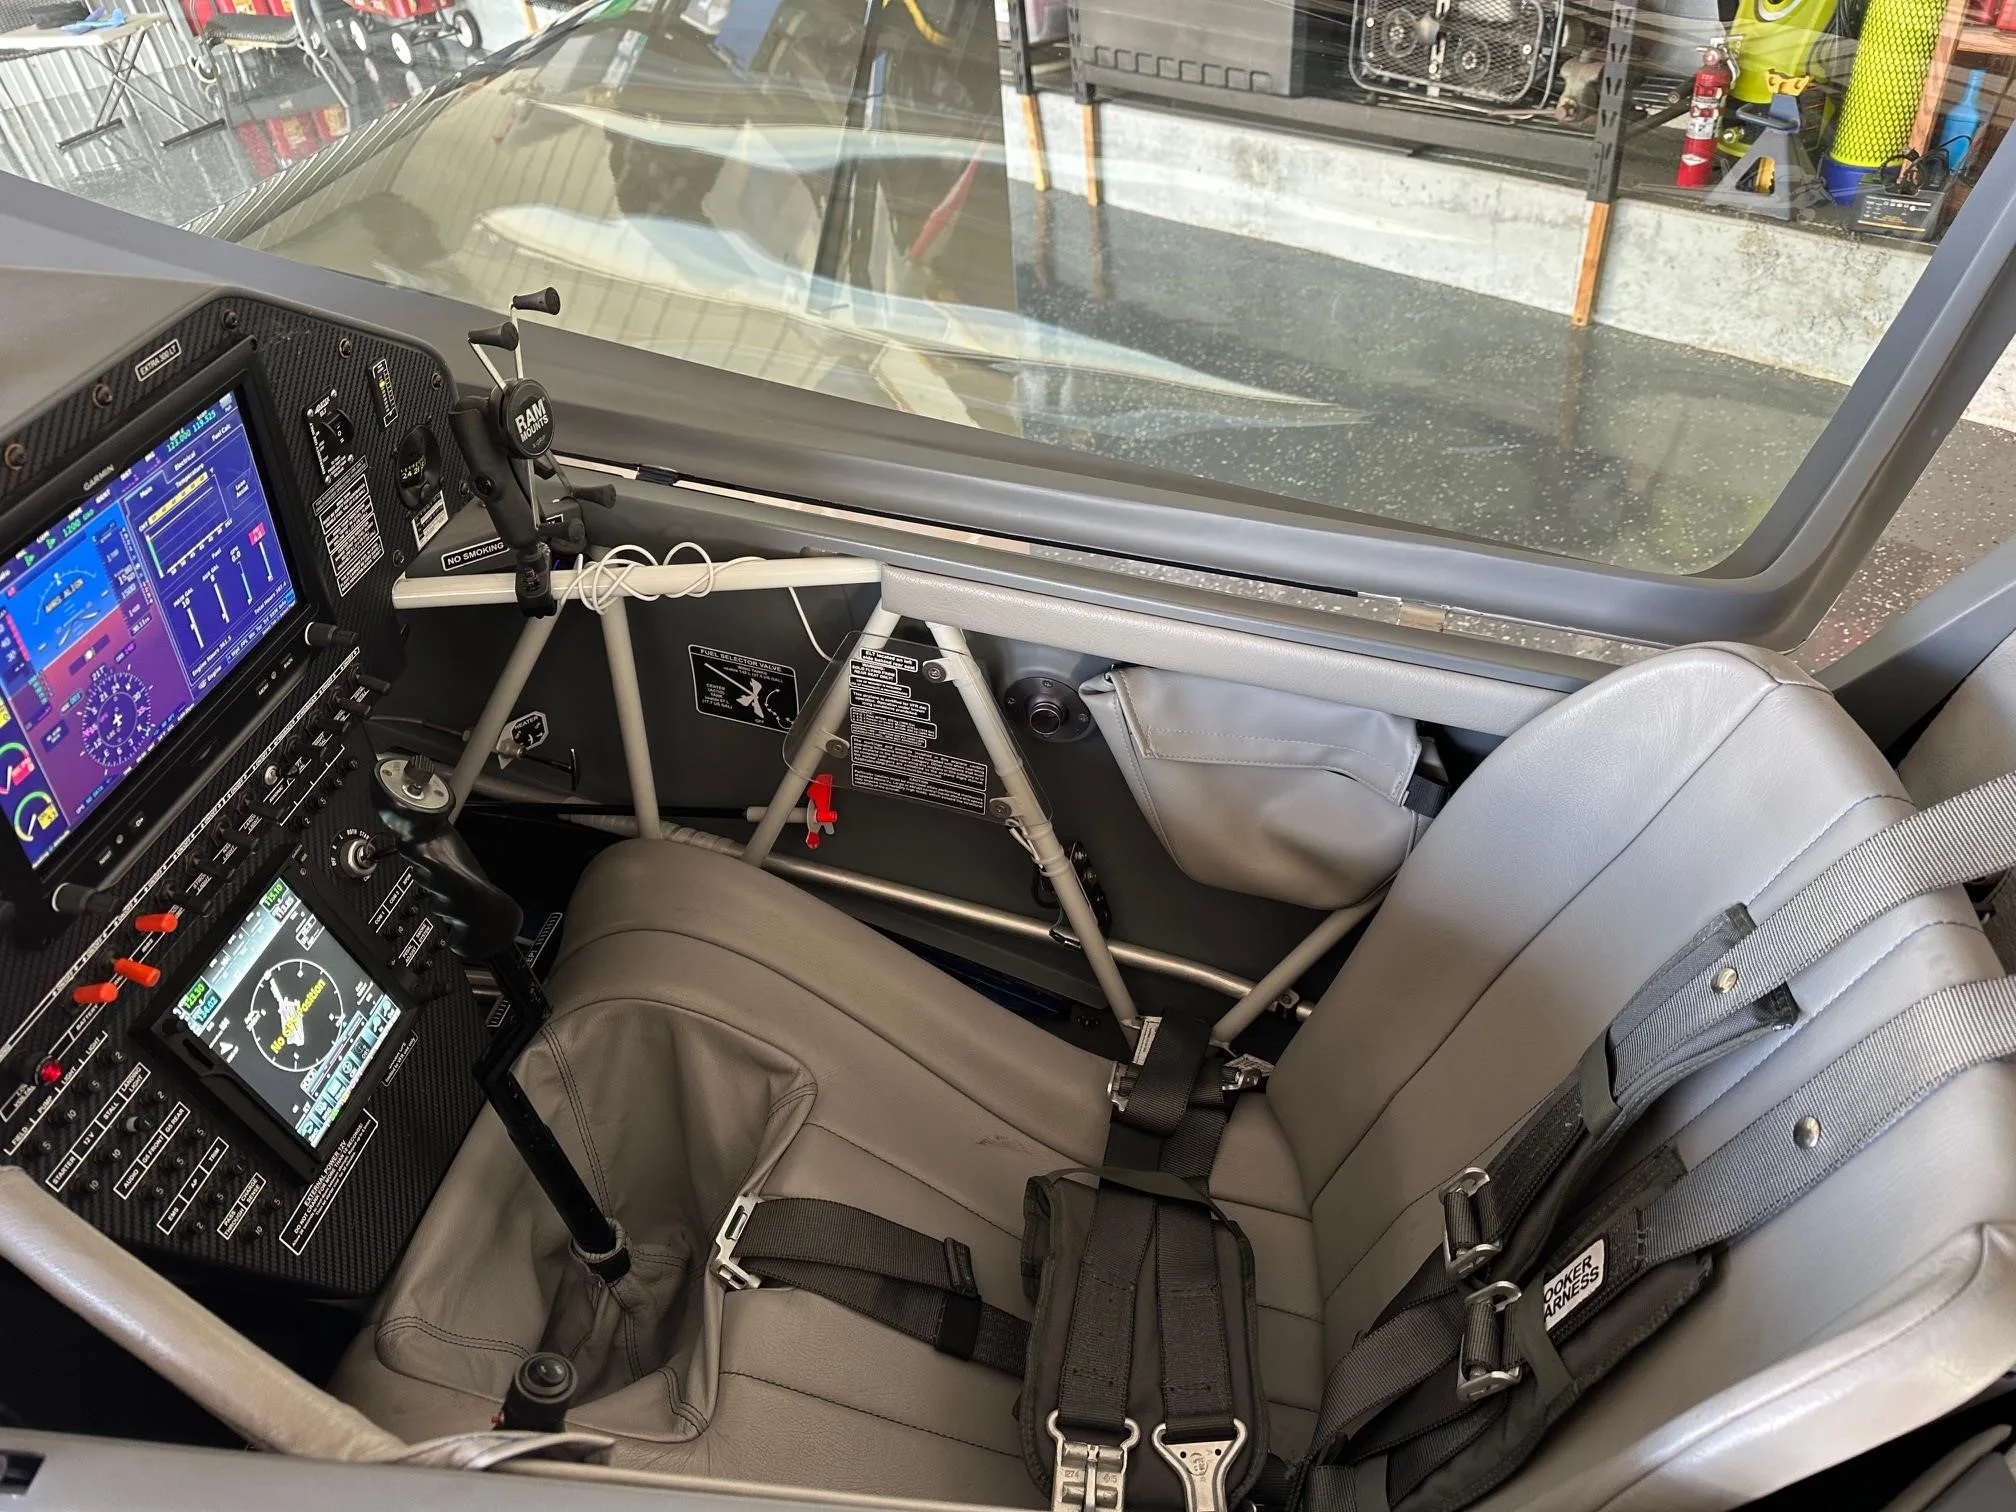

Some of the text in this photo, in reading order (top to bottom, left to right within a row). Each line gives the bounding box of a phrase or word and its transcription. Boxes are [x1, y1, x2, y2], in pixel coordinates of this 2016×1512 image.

[515, 399, 546, 433] RAM
[521, 415, 549, 442] MOUNTS
[83, 465, 115, 491] GARMIN
[140, 486, 152, 498] Main
[174, 451, 196, 471] Electrical
[175, 463, 204, 488] Temperature
[212, 547, 222, 559] Fuel
[448, 542, 504, 565] NO SMOKING
[192, 659, 207, 676] Engine
[700, 649, 782, 672] FUEL SELECTOR VALVE
[515, 716, 538, 730] HEATER
[360, 830, 370, 840] STAR
[265, 884, 283, 907] 115.10
[183, 985, 205, 1009] 123.30
[271, 1034, 285, 1054] No
[297, 978, 326, 1015] Position
[86, 1037, 100, 1055] LIGHT
[61, 1066, 76, 1085] LIGHT
[121, 1067, 142, 1092] LANDING
[129, 1075, 143, 1093] LIGHT
[37, 1096, 52, 1114] PUMP
[67, 1110, 76, 1118] 10
[103, 1101, 119, 1120] STALL
[172, 1109, 185, 1126] REAR
[12, 1126, 29, 1146] FIELD
[150, 1135, 164, 1155] FRONT
[112, 1149, 121, 1158] 10
[208, 1148, 220, 1163] TRIM
[52, 1157, 76, 1185] STARTER
[123, 1168, 139, 1189] AUDIO
[302, 1172, 327, 1206] EXTERNAL
[322, 1150, 341, 1174] POWER
[190, 1178, 198, 1189] AP
[240, 1178, 258, 1202] CHARGE
[293, 1223, 302, 1233] DO
[298, 1211, 309, 1224] NOT
[305, 1193, 321, 1213] CRANK
[317, 1182, 327, 1194] FOR
[323, 1167, 337, 1183] MORE
[333, 1153, 345, 1168] THAN
[246, 1185, 261, 1204] SENSE
[168, 1207, 179, 1221] EMS
[224, 1211, 237, 1227] PASS
[224, 1208, 245, 1237] THROUGH
[1544, 1255, 1593, 1302] OOKER
[1544, 1266, 1599, 1318] ARNESS
